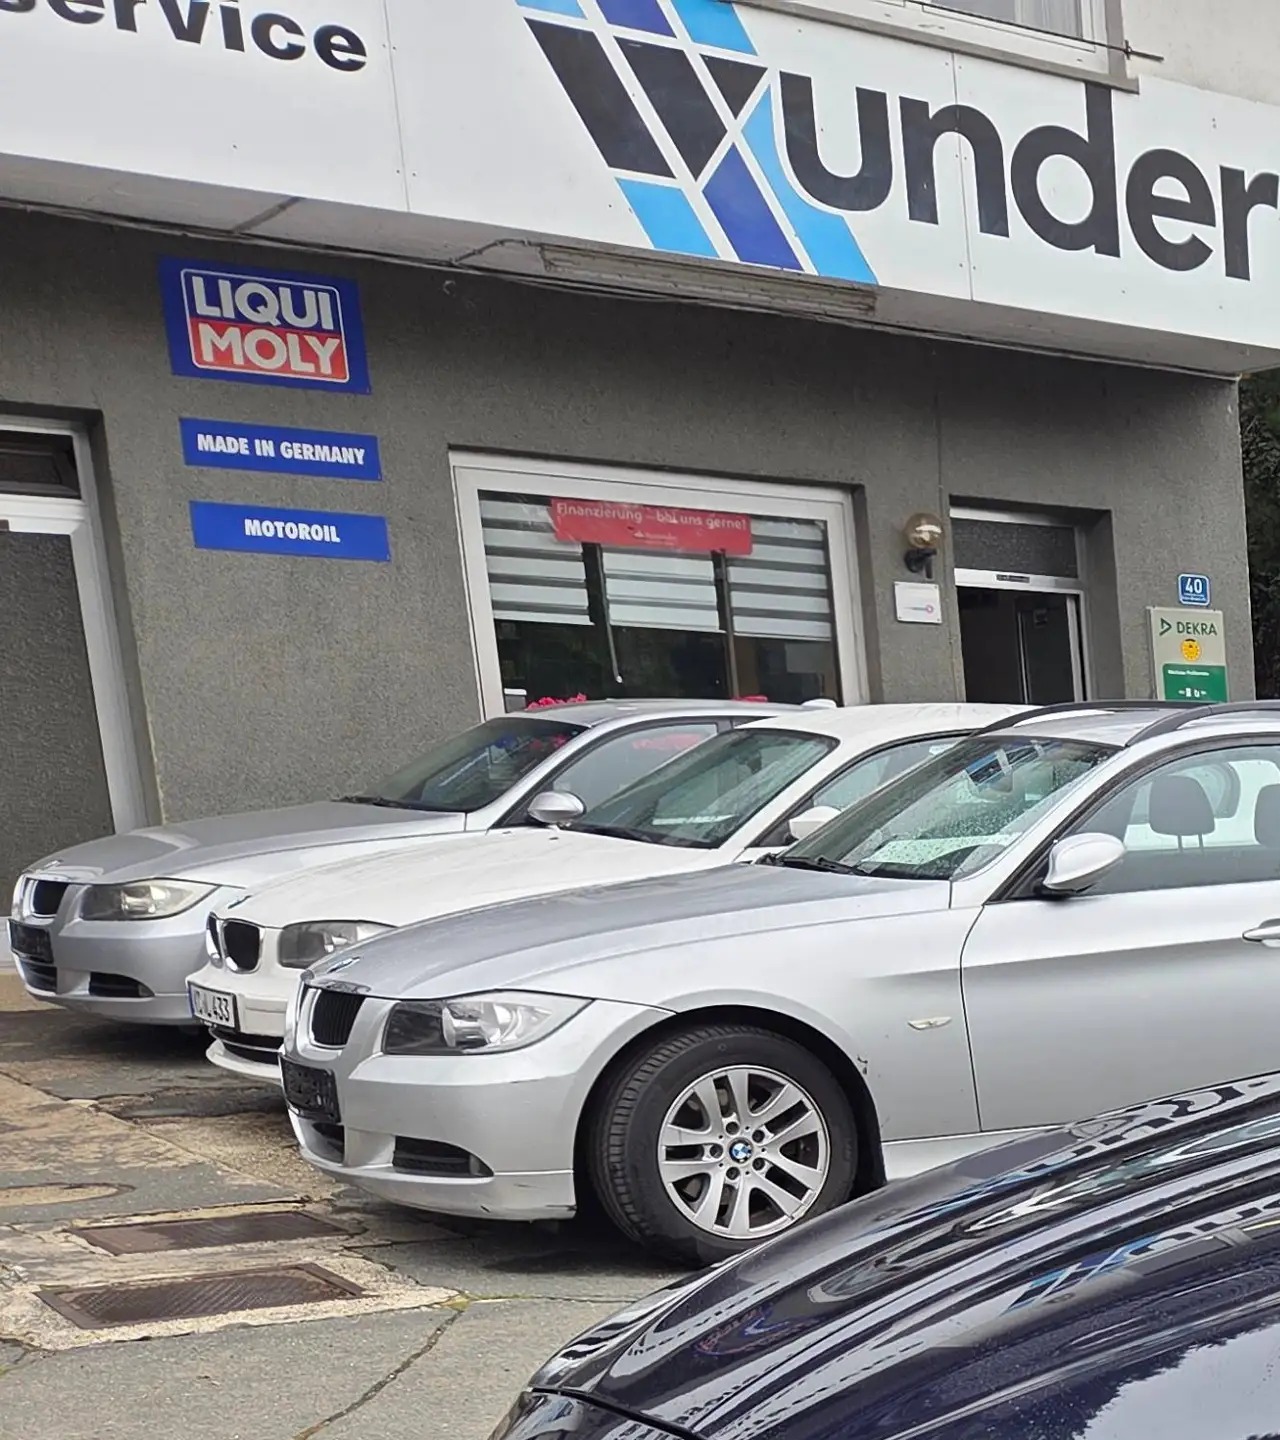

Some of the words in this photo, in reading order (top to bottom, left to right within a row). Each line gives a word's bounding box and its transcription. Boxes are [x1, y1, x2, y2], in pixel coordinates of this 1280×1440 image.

[191, 276, 336, 329] LIQUI
[198, 323, 341, 376] MOLY
[197, 434, 248, 455] MADE
[254, 439, 275, 458] IN
[280, 441, 365, 466] GERMANY
[557, 503, 642, 523] Finanzierung
[682, 515, 702, 526] uns
[245, 519, 341, 543] MOTOROIL
[1185, 578, 1202, 594] 40
[1177, 621, 1217, 635] DEKRA
